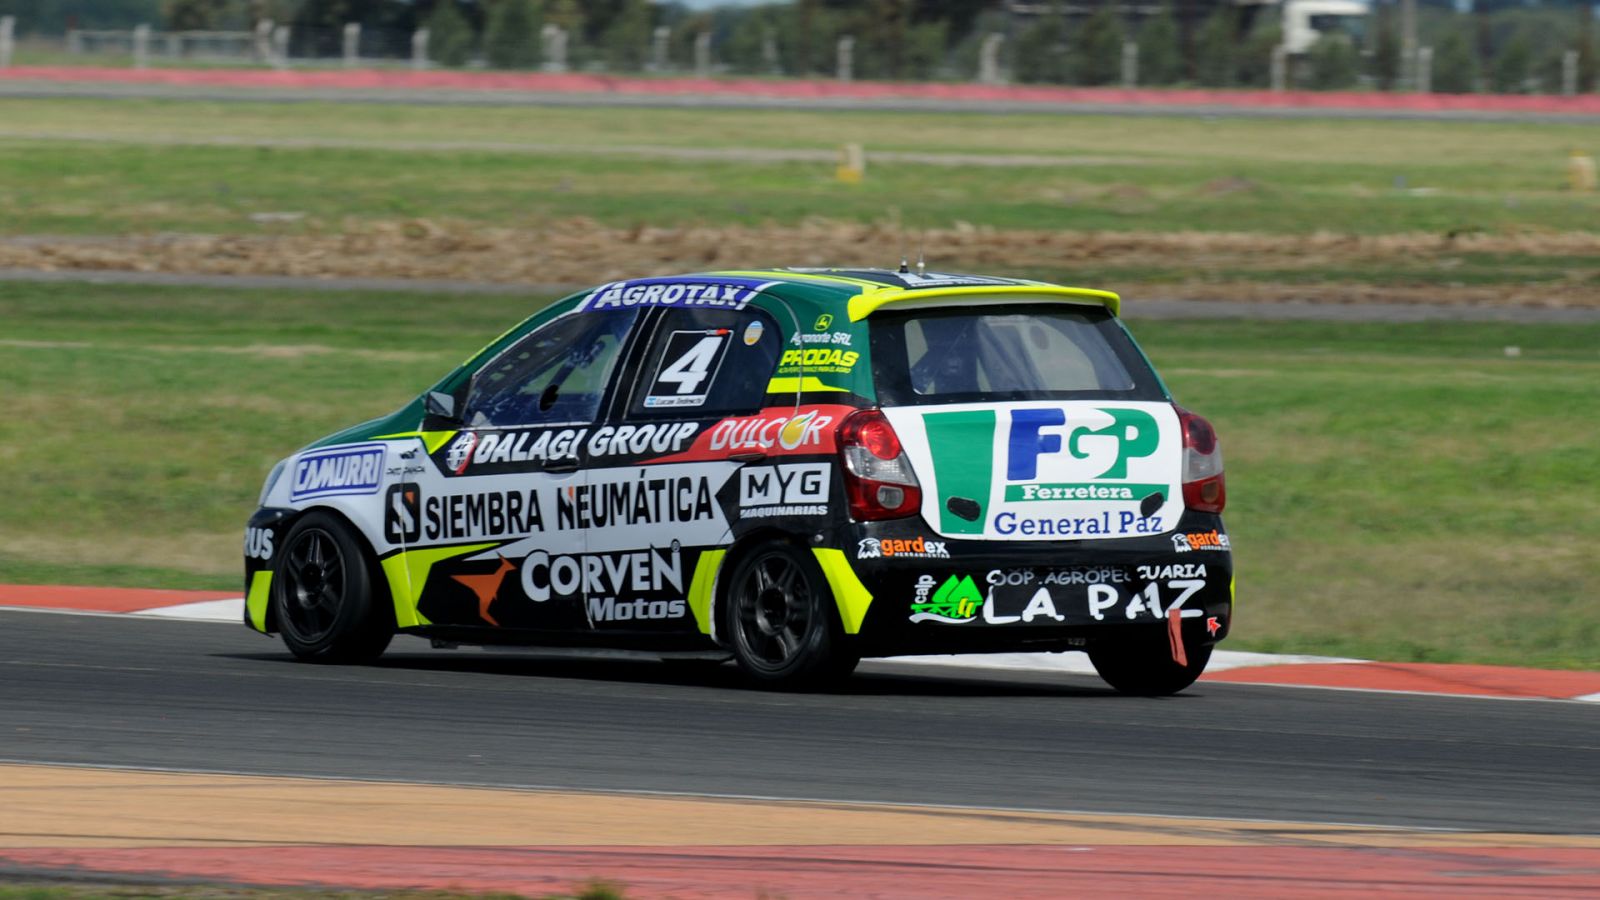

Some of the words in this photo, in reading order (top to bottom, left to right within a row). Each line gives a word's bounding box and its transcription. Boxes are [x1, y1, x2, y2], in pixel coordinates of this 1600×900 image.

[593, 282, 745, 309] AGROTAX
[831, 332, 852, 346] SRL
[658, 336, 723, 394] 4
[780, 349, 860, 367] PRODAS
[473, 428, 588, 463] DALAGI
[587, 422, 699, 457] GROUP
[1006, 408, 1160, 481] FGP
[295, 453, 381, 491] CAMURRI
[748, 465, 822, 503] MYG
[425, 489, 544, 540] SIEMBRA
[557, 469, 713, 531] NEUMÁTICA
[1021, 484, 1134, 500] Ferretera
[740, 505, 828, 519] MAQUINARIAS
[994, 511, 1110, 535] General
[1118, 511, 1163, 533] Paz
[881, 535, 947, 557] gardex
[521, 546, 684, 602] CORVEN
[914, 574, 937, 603] calp
[587, 598, 685, 621] Motos
[983, 585, 1065, 624] LA
[1087, 580, 1207, 621] PAZ
